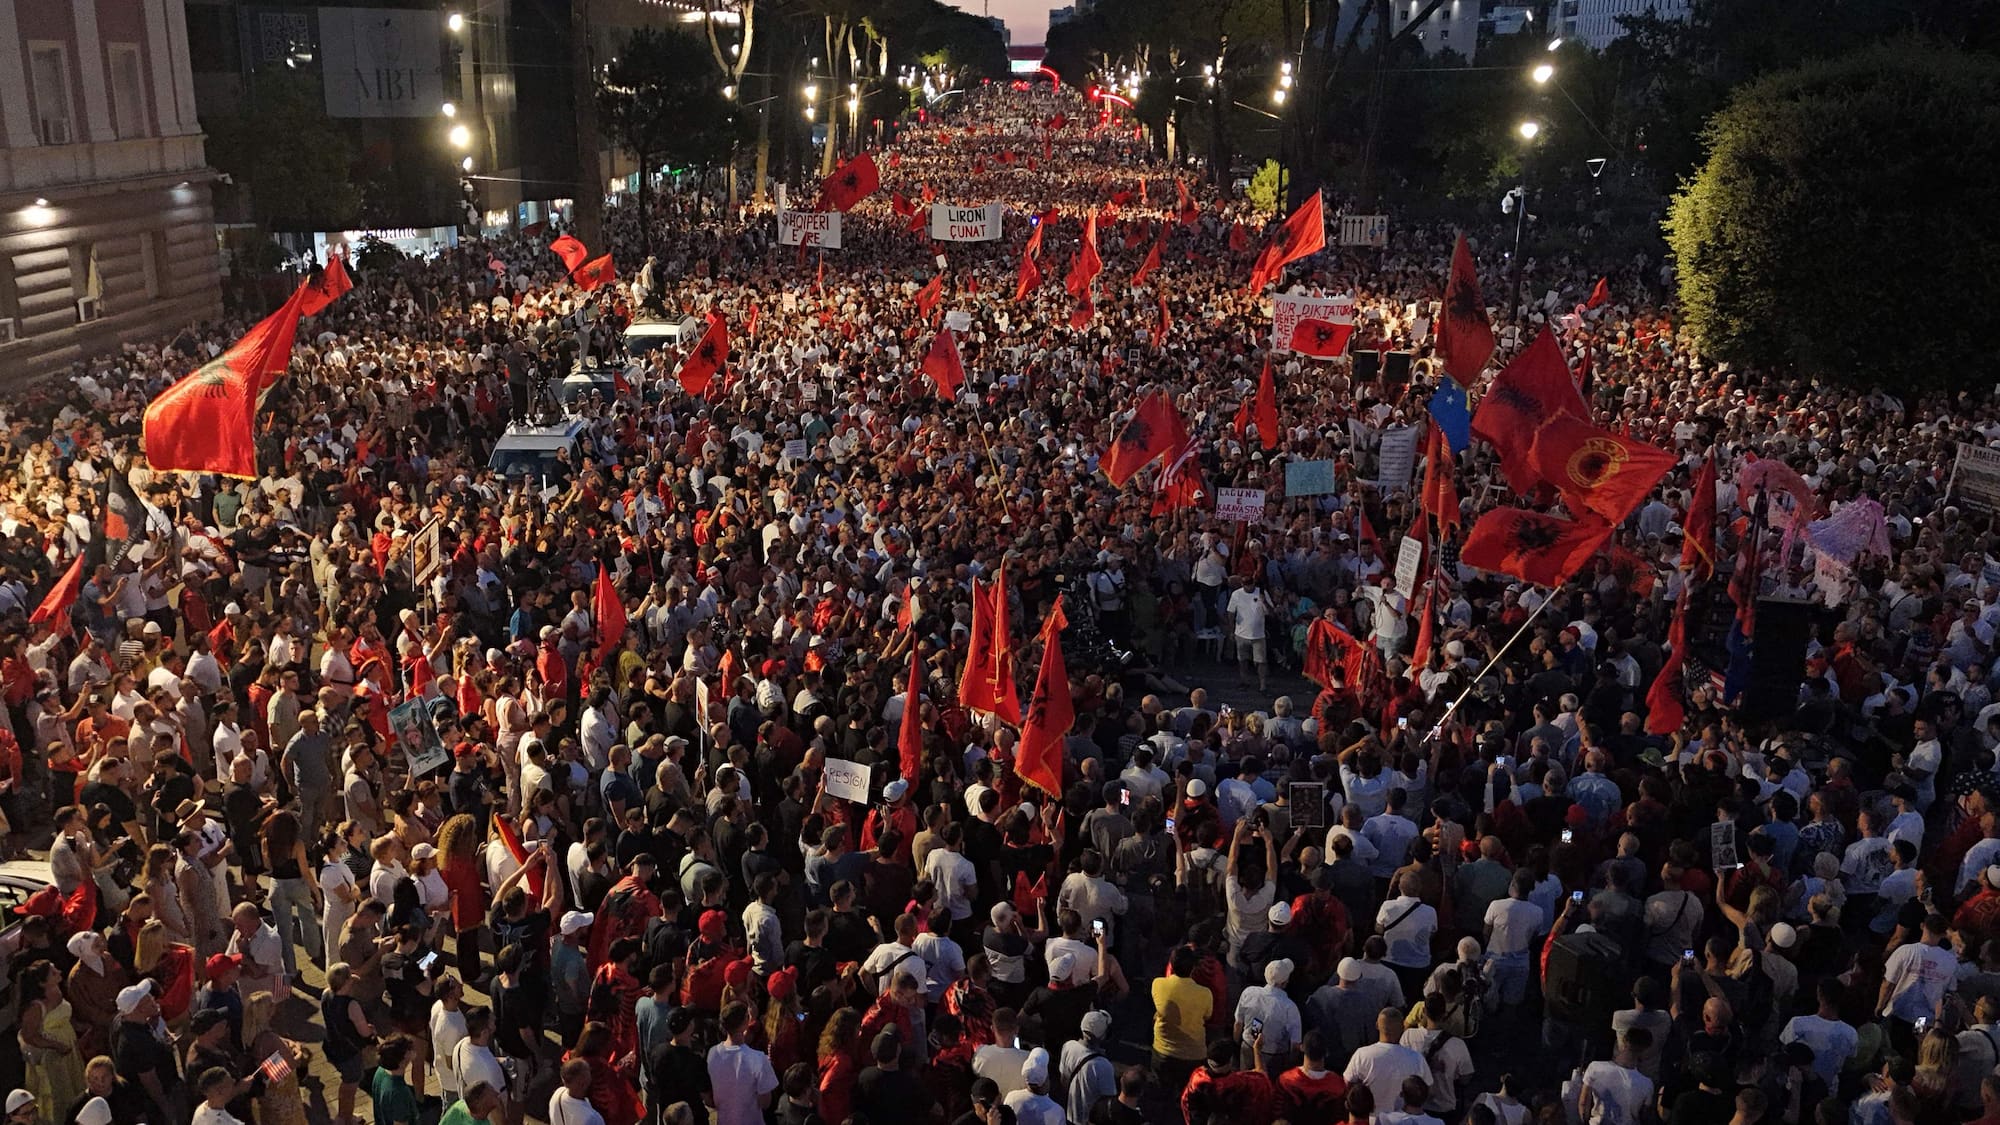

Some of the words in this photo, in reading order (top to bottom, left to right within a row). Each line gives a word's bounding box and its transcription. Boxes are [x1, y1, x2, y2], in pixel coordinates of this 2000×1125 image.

[948, 207, 986, 222] LIRONI
[792, 229, 799, 241] E
[806, 231, 821, 244] RE
[950, 224, 986, 240] ÇUNAT
[1275, 300, 1297, 315] KUR
[1302, 303, 1354, 317] DIKTATURA
[1219, 489, 1258, 498] LAGUNA
[829, 767, 867, 790] RESIGN
